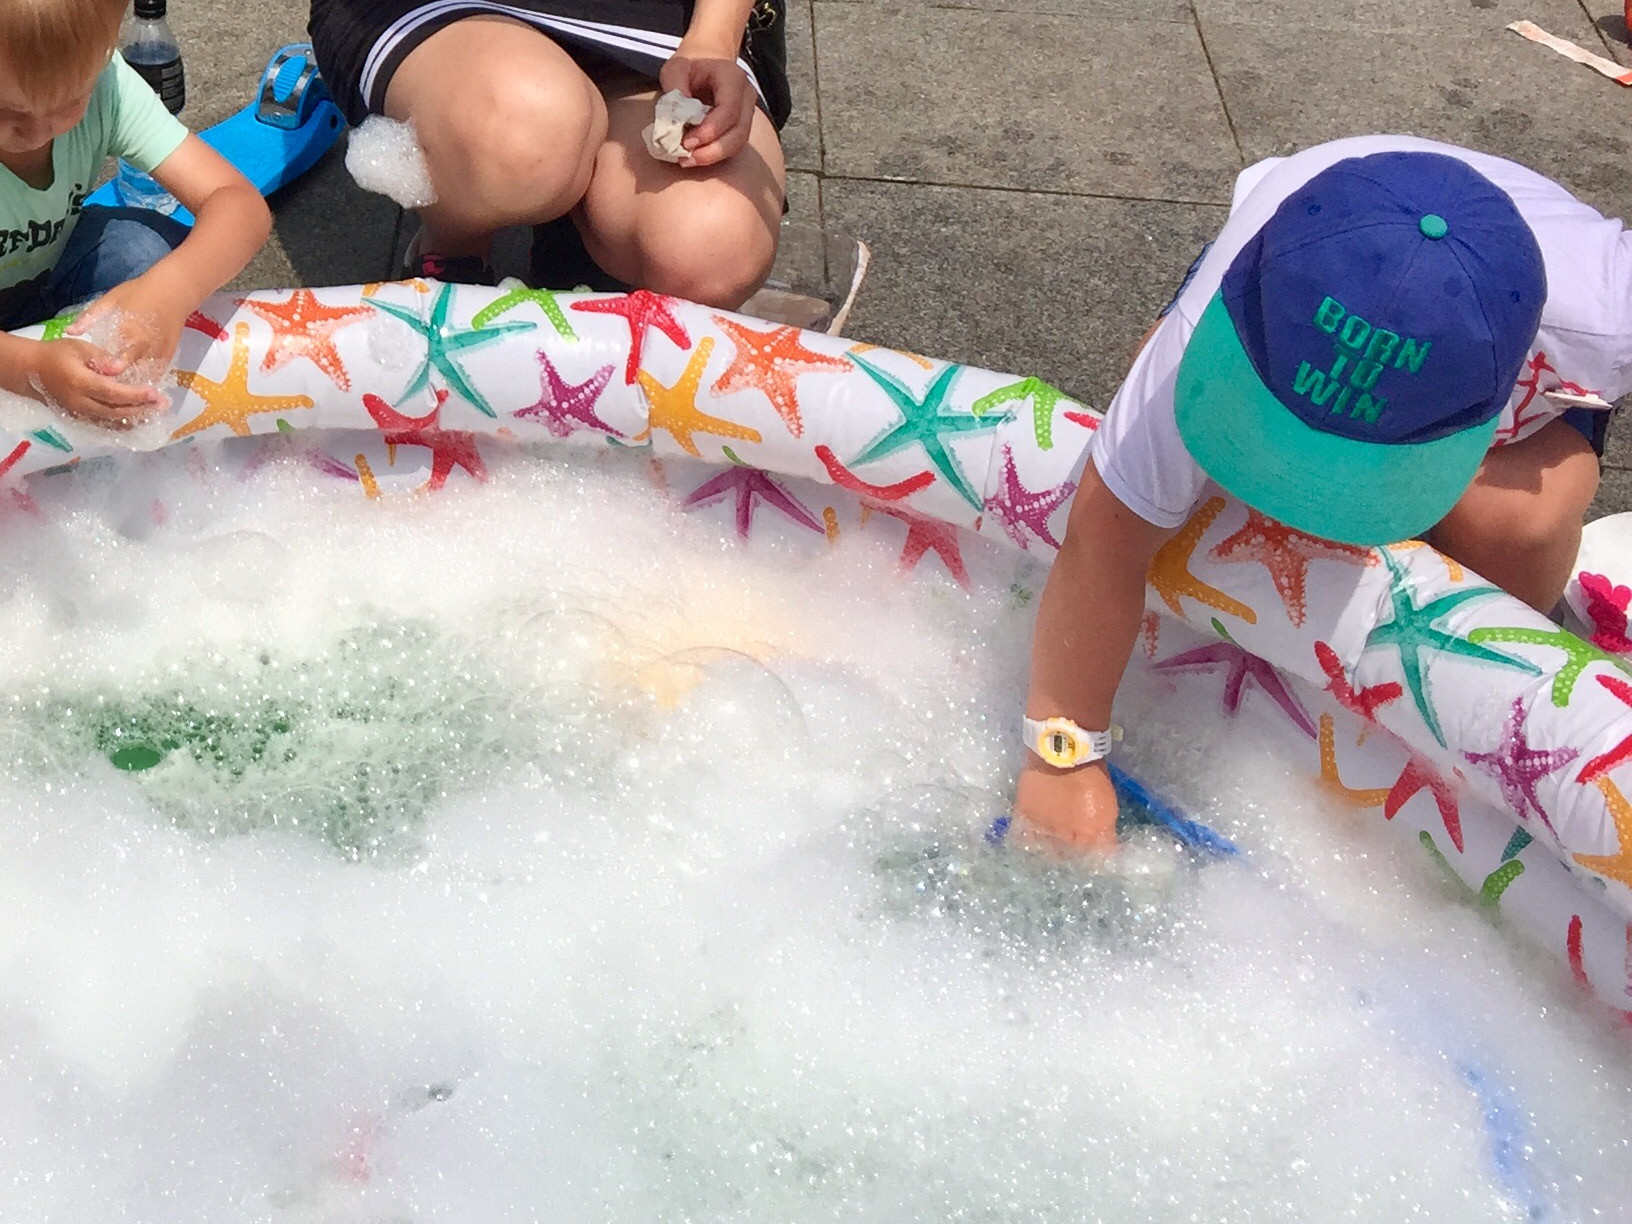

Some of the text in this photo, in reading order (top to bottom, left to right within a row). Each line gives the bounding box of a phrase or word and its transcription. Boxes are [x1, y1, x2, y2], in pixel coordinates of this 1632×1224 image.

[1313, 295, 1433, 373] BORN
[1330, 342, 1384, 390] TO
[1292, 359, 1389, 424] WIN
